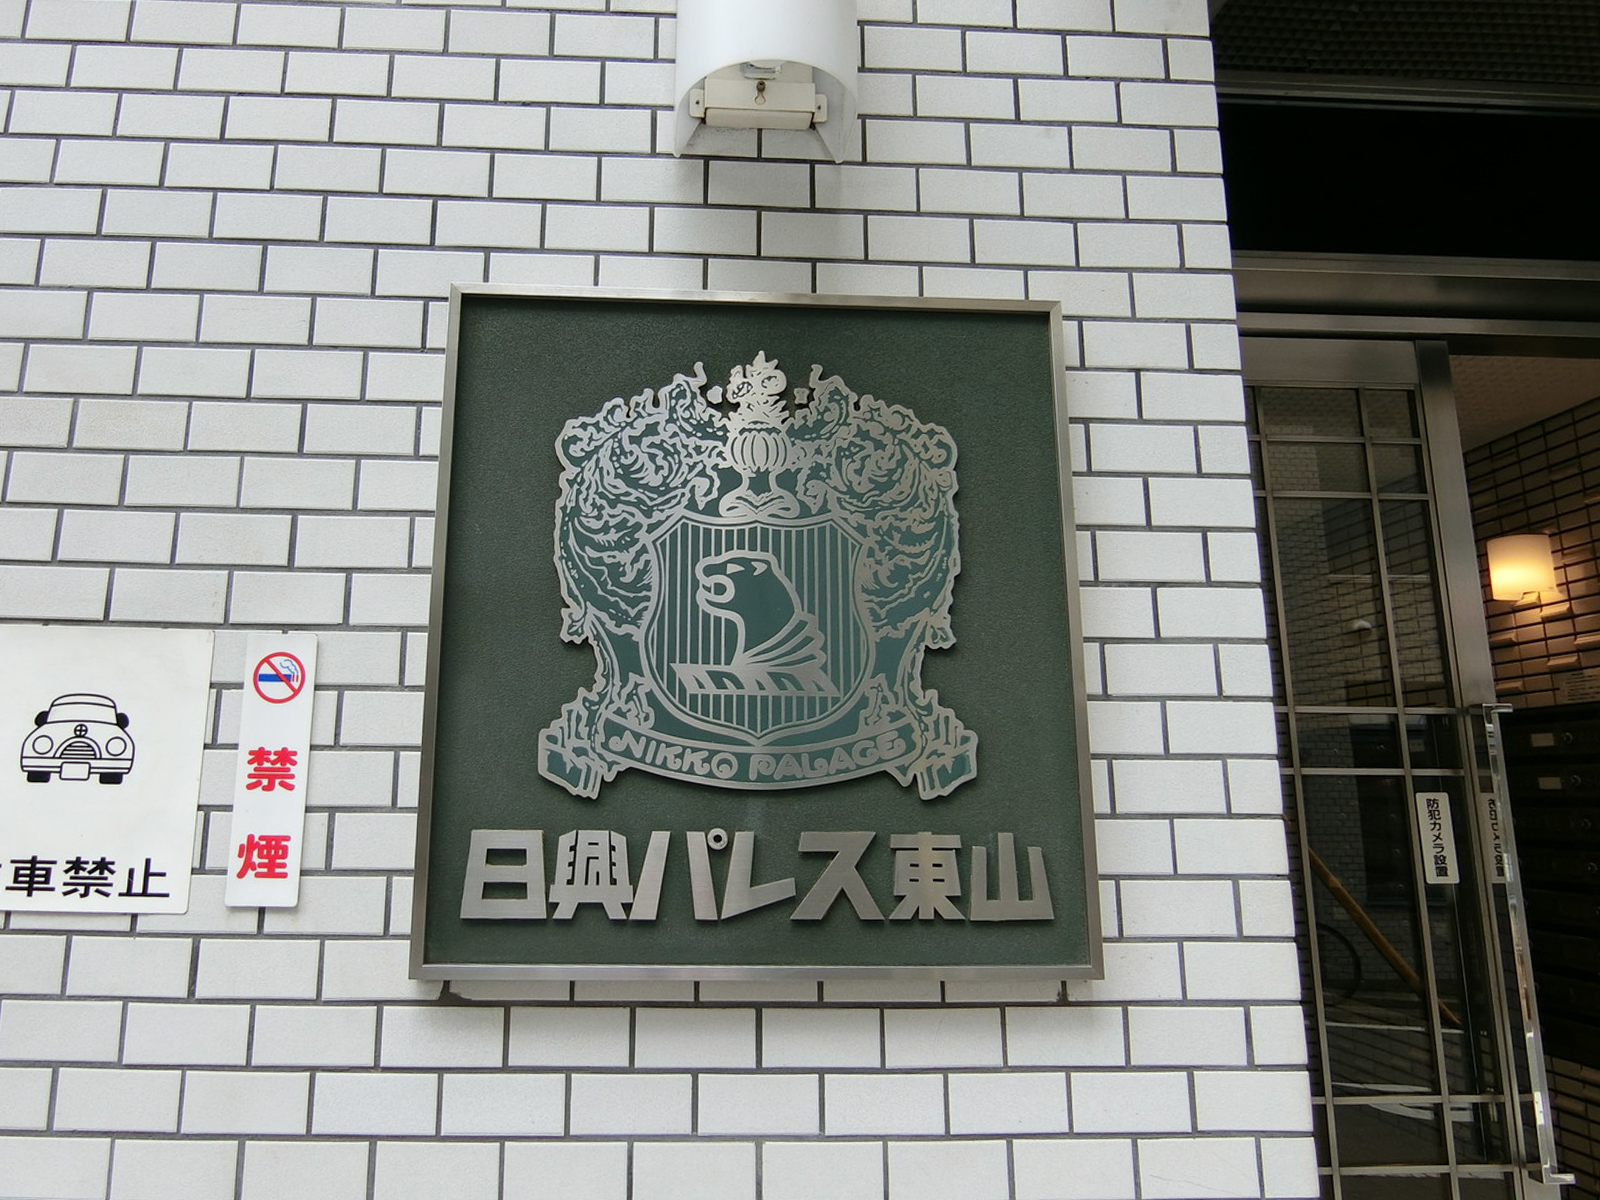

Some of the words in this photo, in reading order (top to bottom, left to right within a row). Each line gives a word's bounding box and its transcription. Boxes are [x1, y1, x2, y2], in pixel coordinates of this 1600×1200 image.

[608, 730, 739, 780] NIKKO
[236, 746, 299, 880] 禁煙
[1425, 797, 1449, 878] 防犯カメラ設置
[0, 855, 171, 899] 車禁止
[459, 827, 1055, 922] 日興パレス東山
